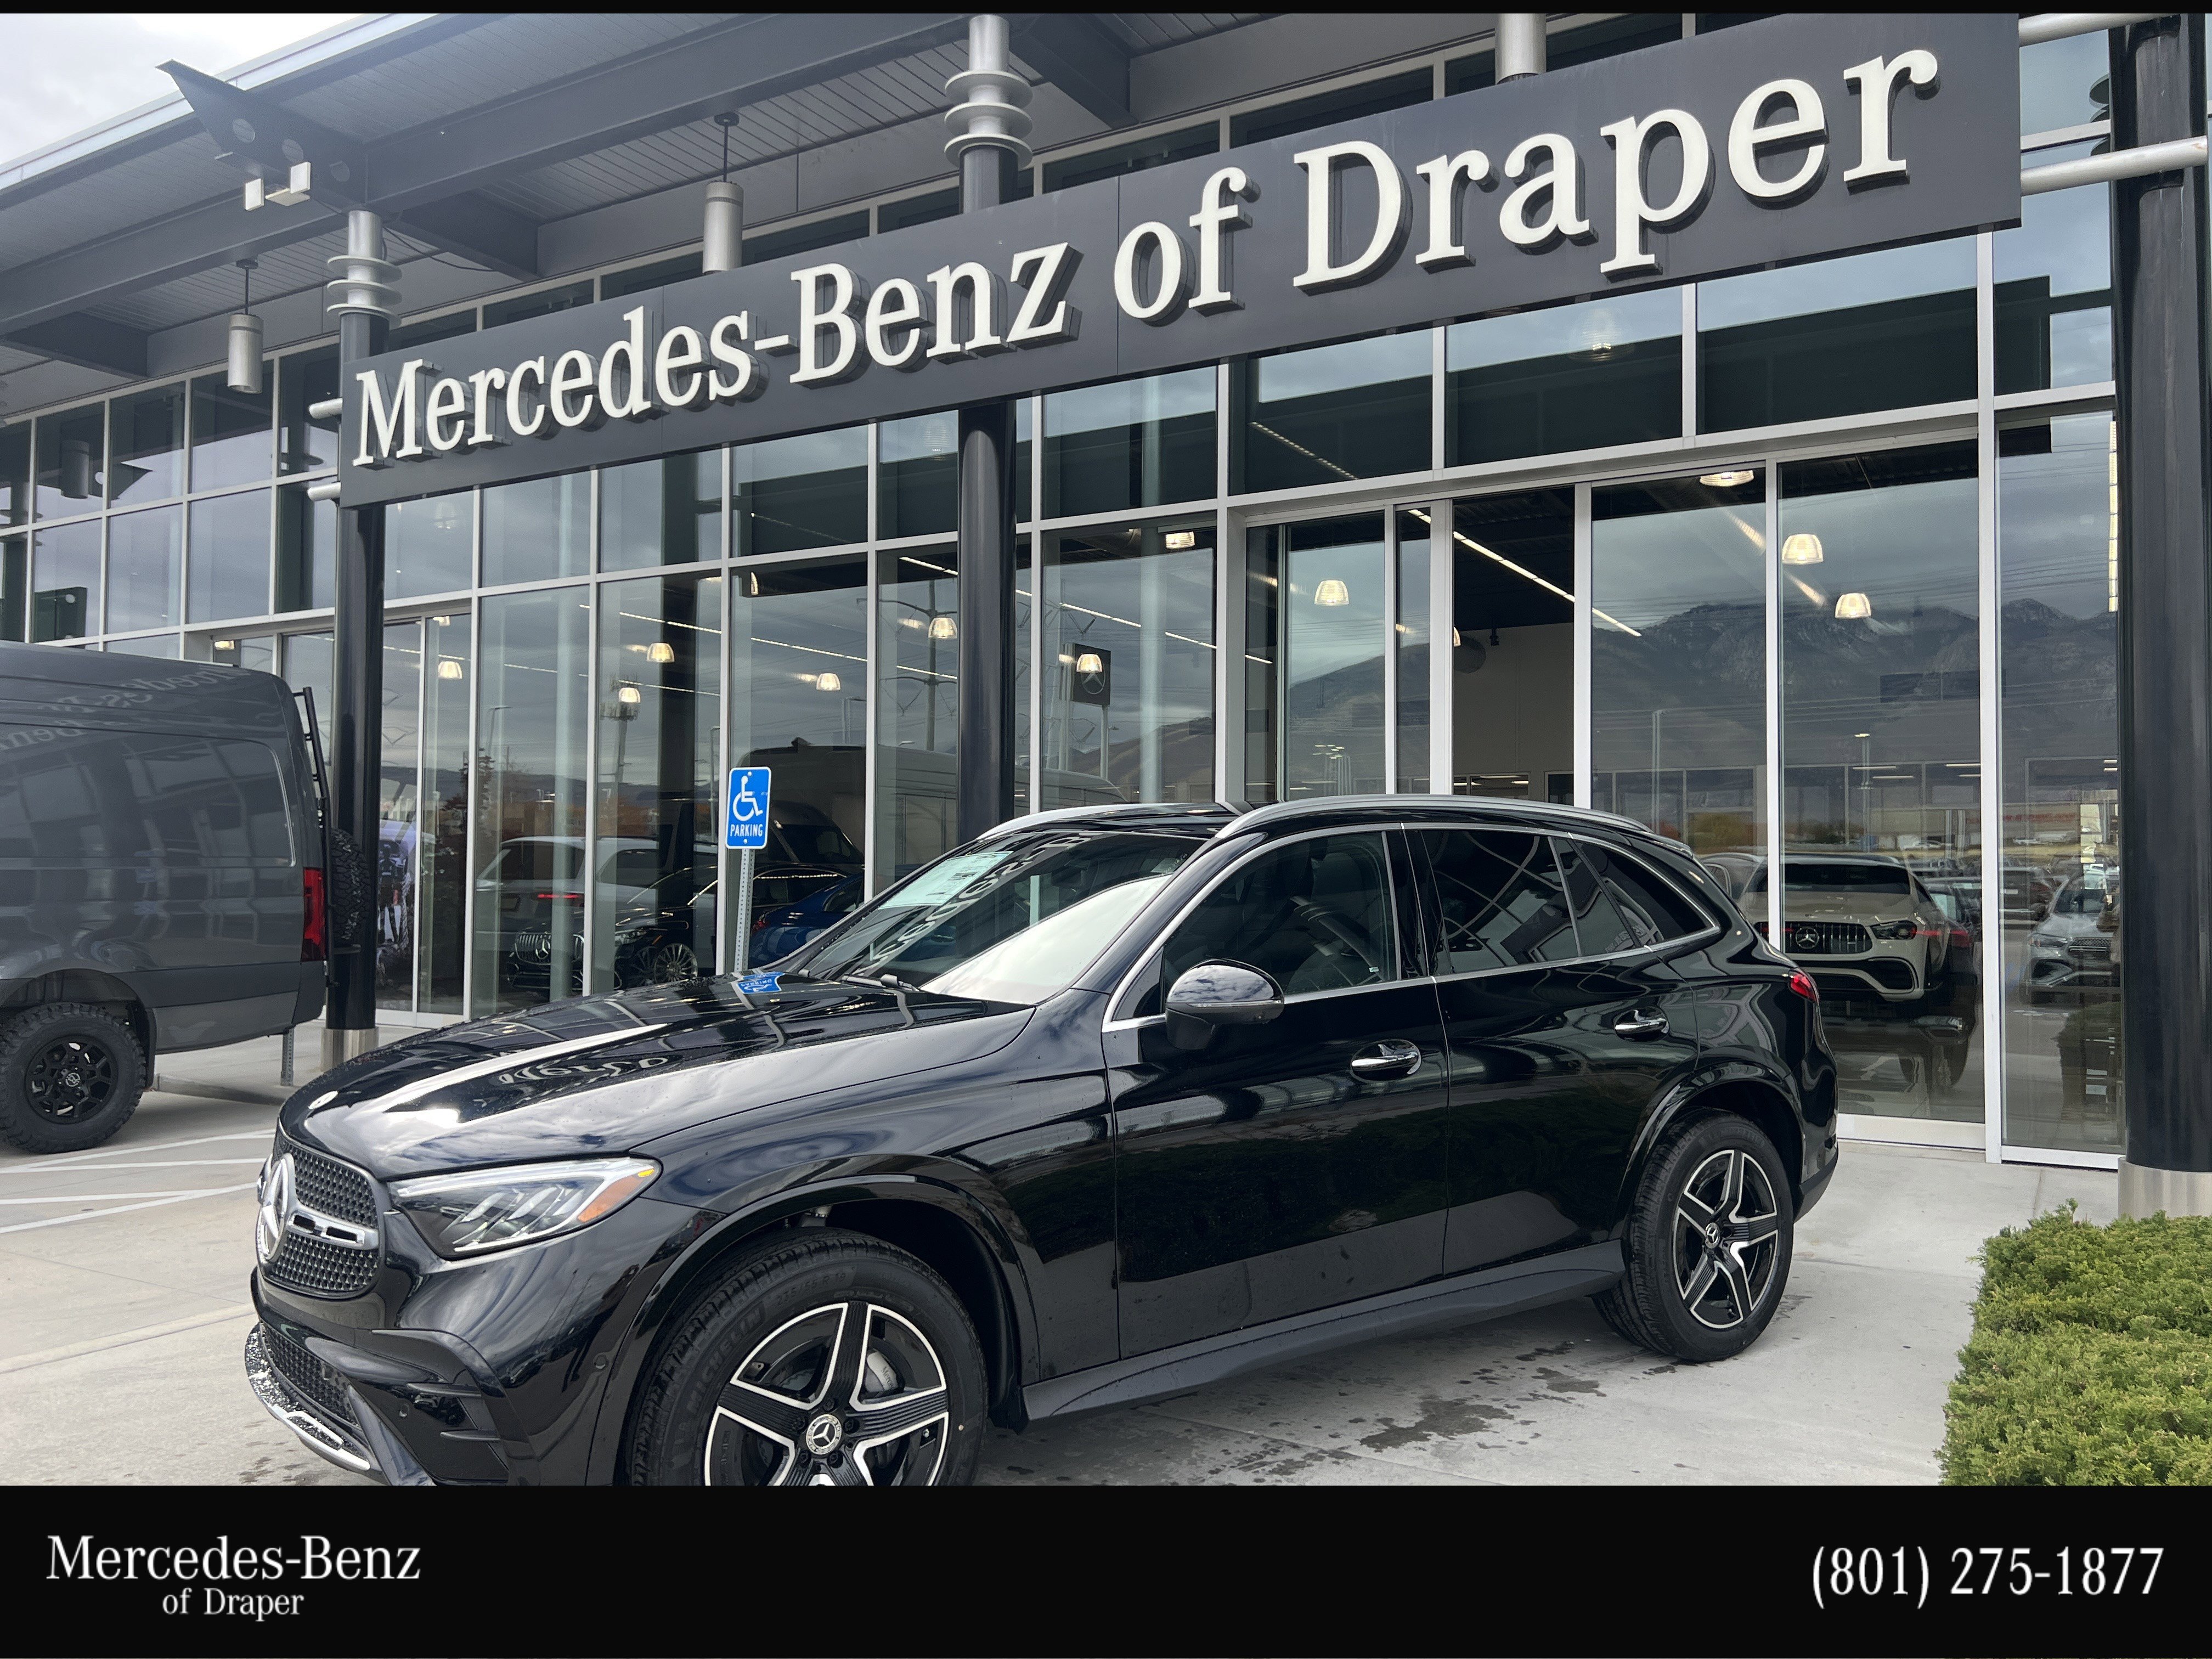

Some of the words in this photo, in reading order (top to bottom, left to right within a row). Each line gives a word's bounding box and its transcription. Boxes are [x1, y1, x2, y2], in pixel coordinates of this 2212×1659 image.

[353, 241, 1069, 467] Mercedes-Benz
[1114, 166, 1249, 319] of
[1293, 49, 1938, 287] Draper
[730, 823, 763, 837] PARKING
[686, 1307, 762, 1414] MICHELIN
